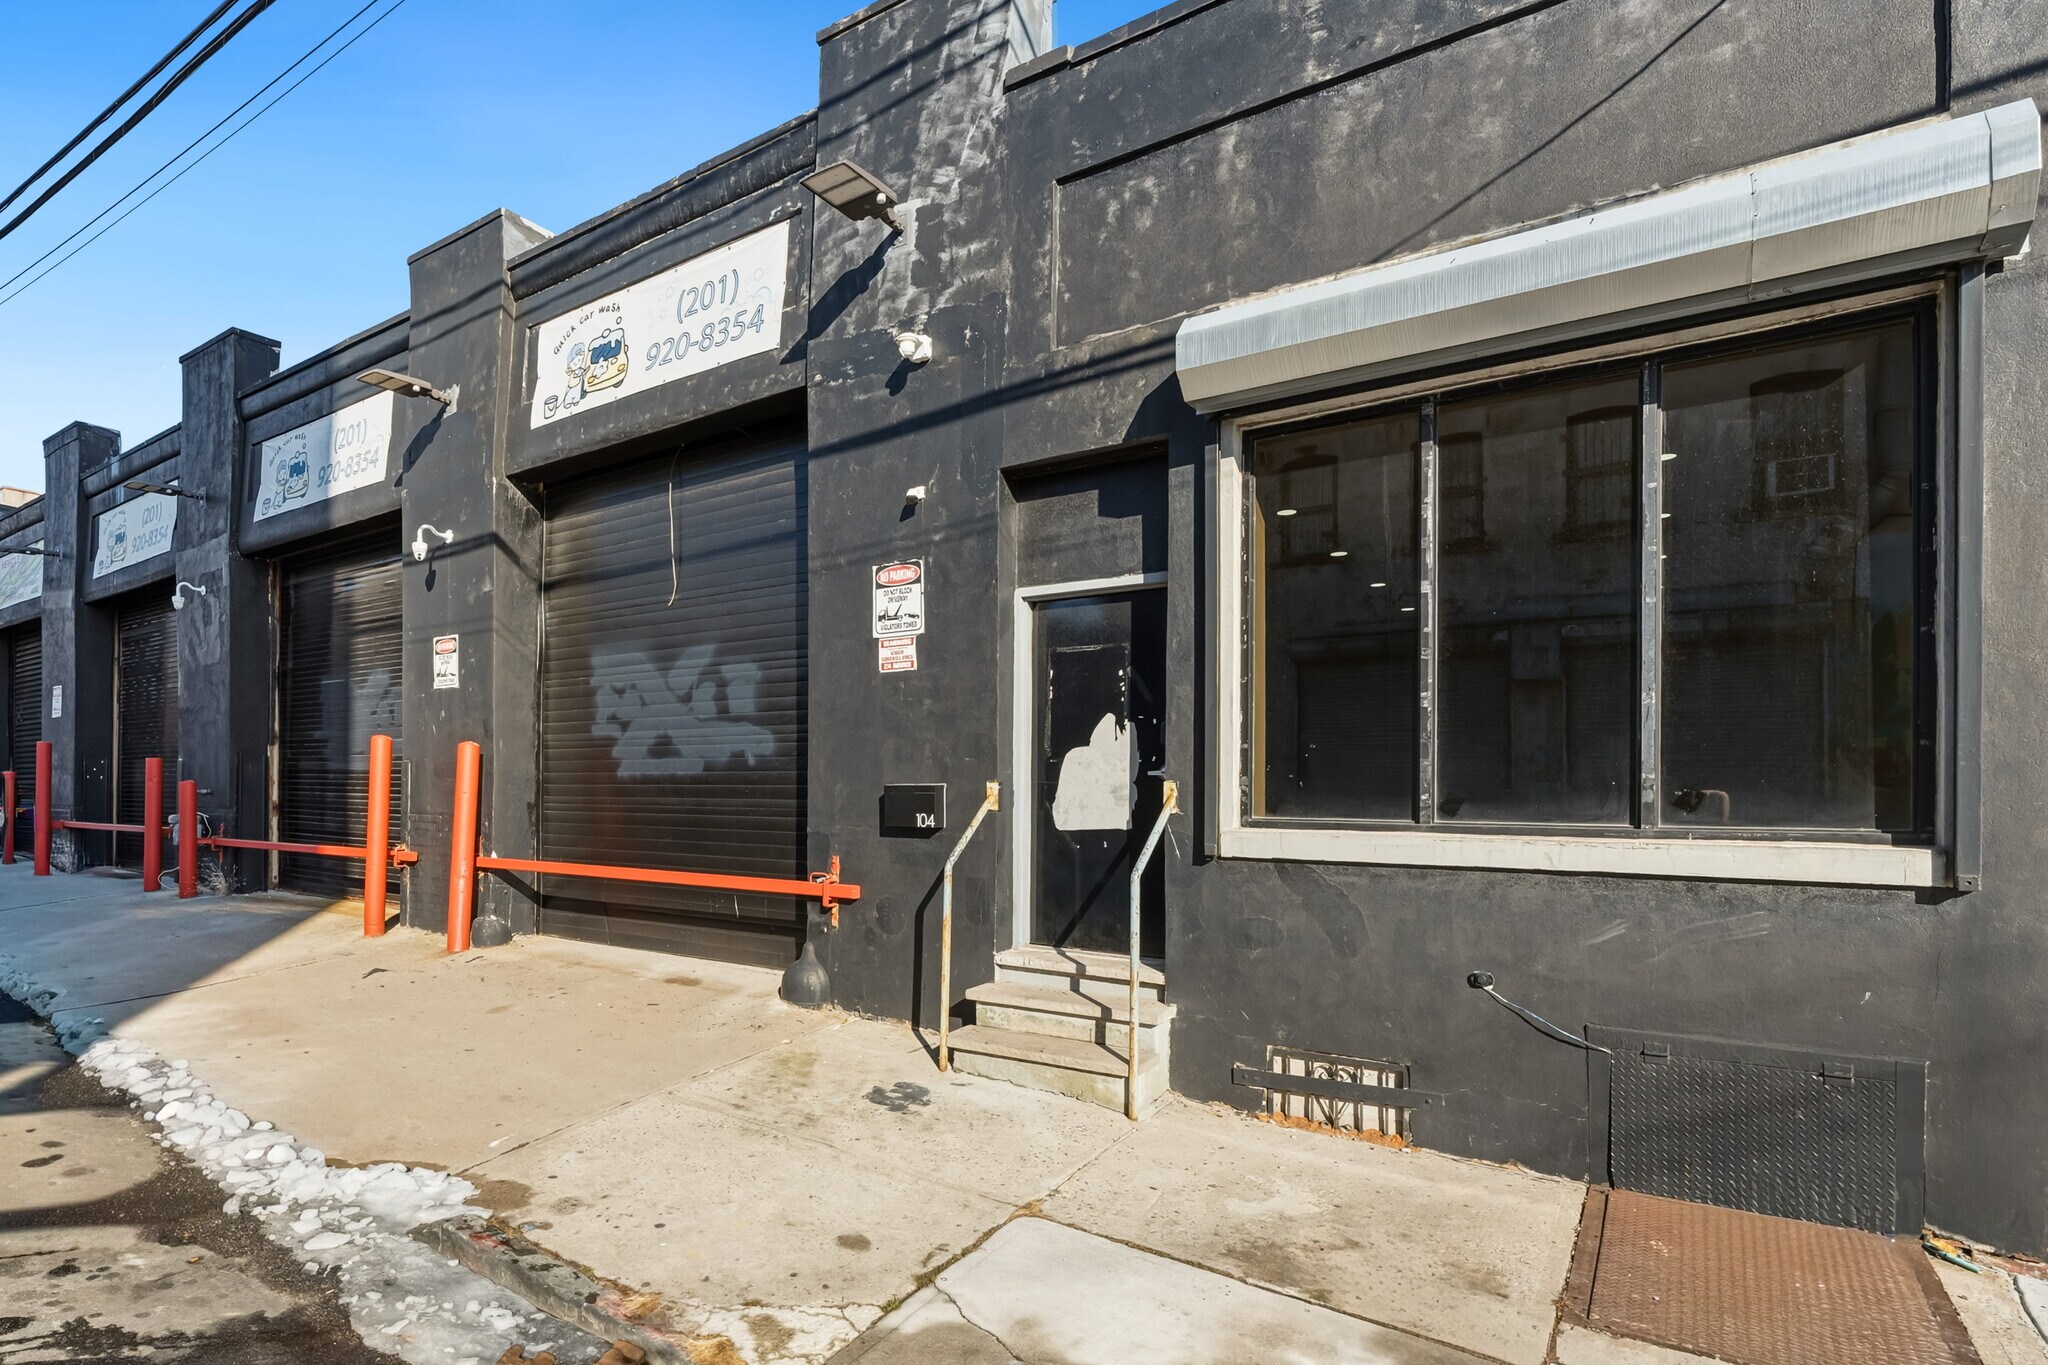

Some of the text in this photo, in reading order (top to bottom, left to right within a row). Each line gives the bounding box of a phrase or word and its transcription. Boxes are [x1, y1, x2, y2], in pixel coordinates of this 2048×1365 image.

[677, 269, 739, 324] (201)
[645, 304, 764, 371] 920-8354
[334, 418, 367, 454] (201)
[317, 447, 379, 488] 920-8354
[142, 502, 163, 528] (201)
[132, 524, 169, 554] 920-8354
[880, 568, 916, 583] NO PARKING
[881, 622, 902, 630] VIOLATORS
[915, 813, 935, 828] 104
